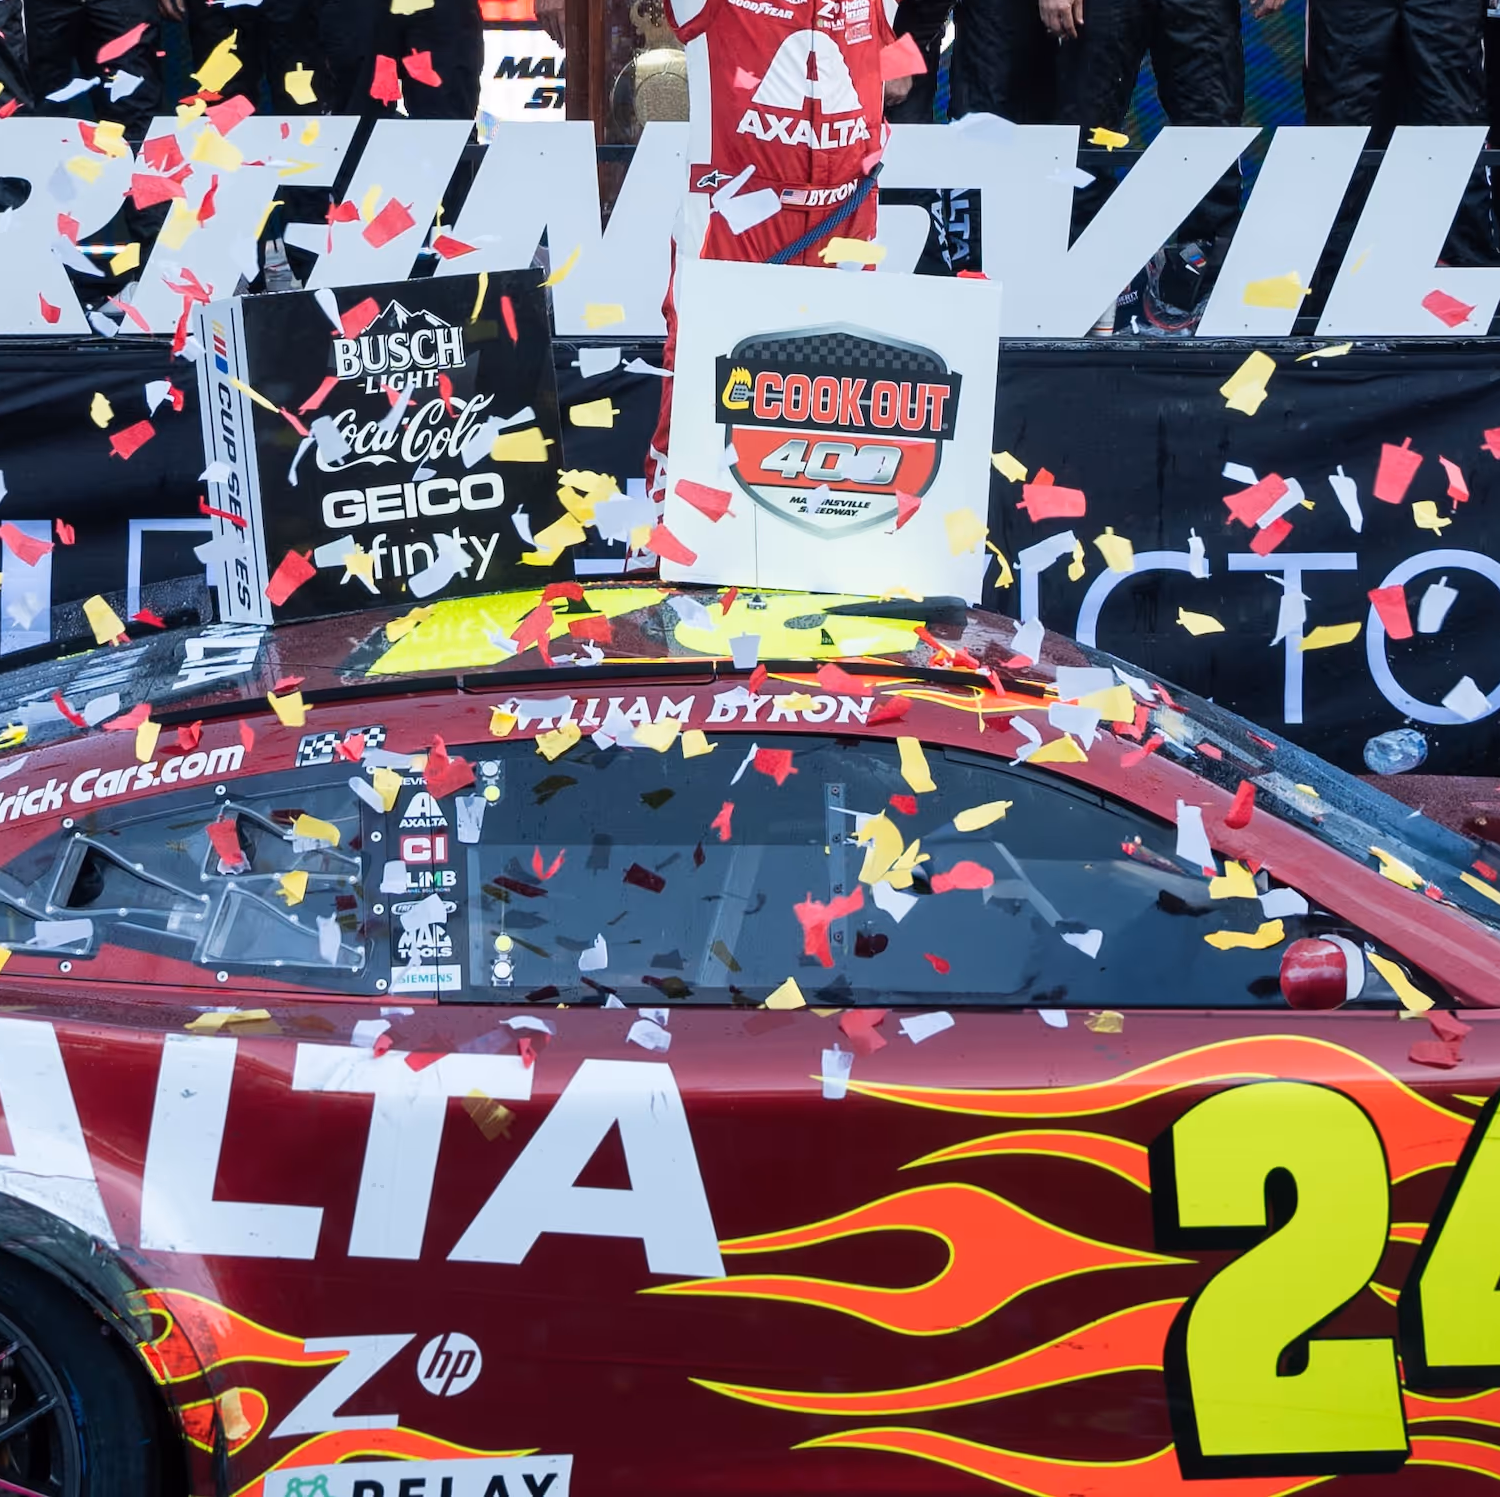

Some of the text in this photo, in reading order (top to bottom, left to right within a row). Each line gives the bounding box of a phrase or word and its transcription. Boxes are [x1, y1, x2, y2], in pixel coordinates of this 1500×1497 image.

[736, 109, 871, 149] AXALTA
[805, 179, 860, 207] BYRON
[332, 325, 466, 380] BUSCH
[365, 369, 437, 394] LIGHT
[753, 370, 950, 432] COOK OUT
[217, 381, 237, 463] CUP
[760, 439, 902, 485] 400
[322, 472, 505, 529] GEICO
[789, 496, 871, 509] MAINSVILLE
[500, 693, 875, 732] WILLIAM BYRON
[70, 744, 246, 805] Cars.com
[399, 818, 449, 829] AXALTA
[403, 837, 445, 862] CI
[405, 870, 457, 889] LIMB
[398, 948, 452, 959] TOOLS
[400, 973, 453, 985] SIEMENS
[420, 1332, 481, 1396] hp
[268, 1333, 418, 1440] Z
